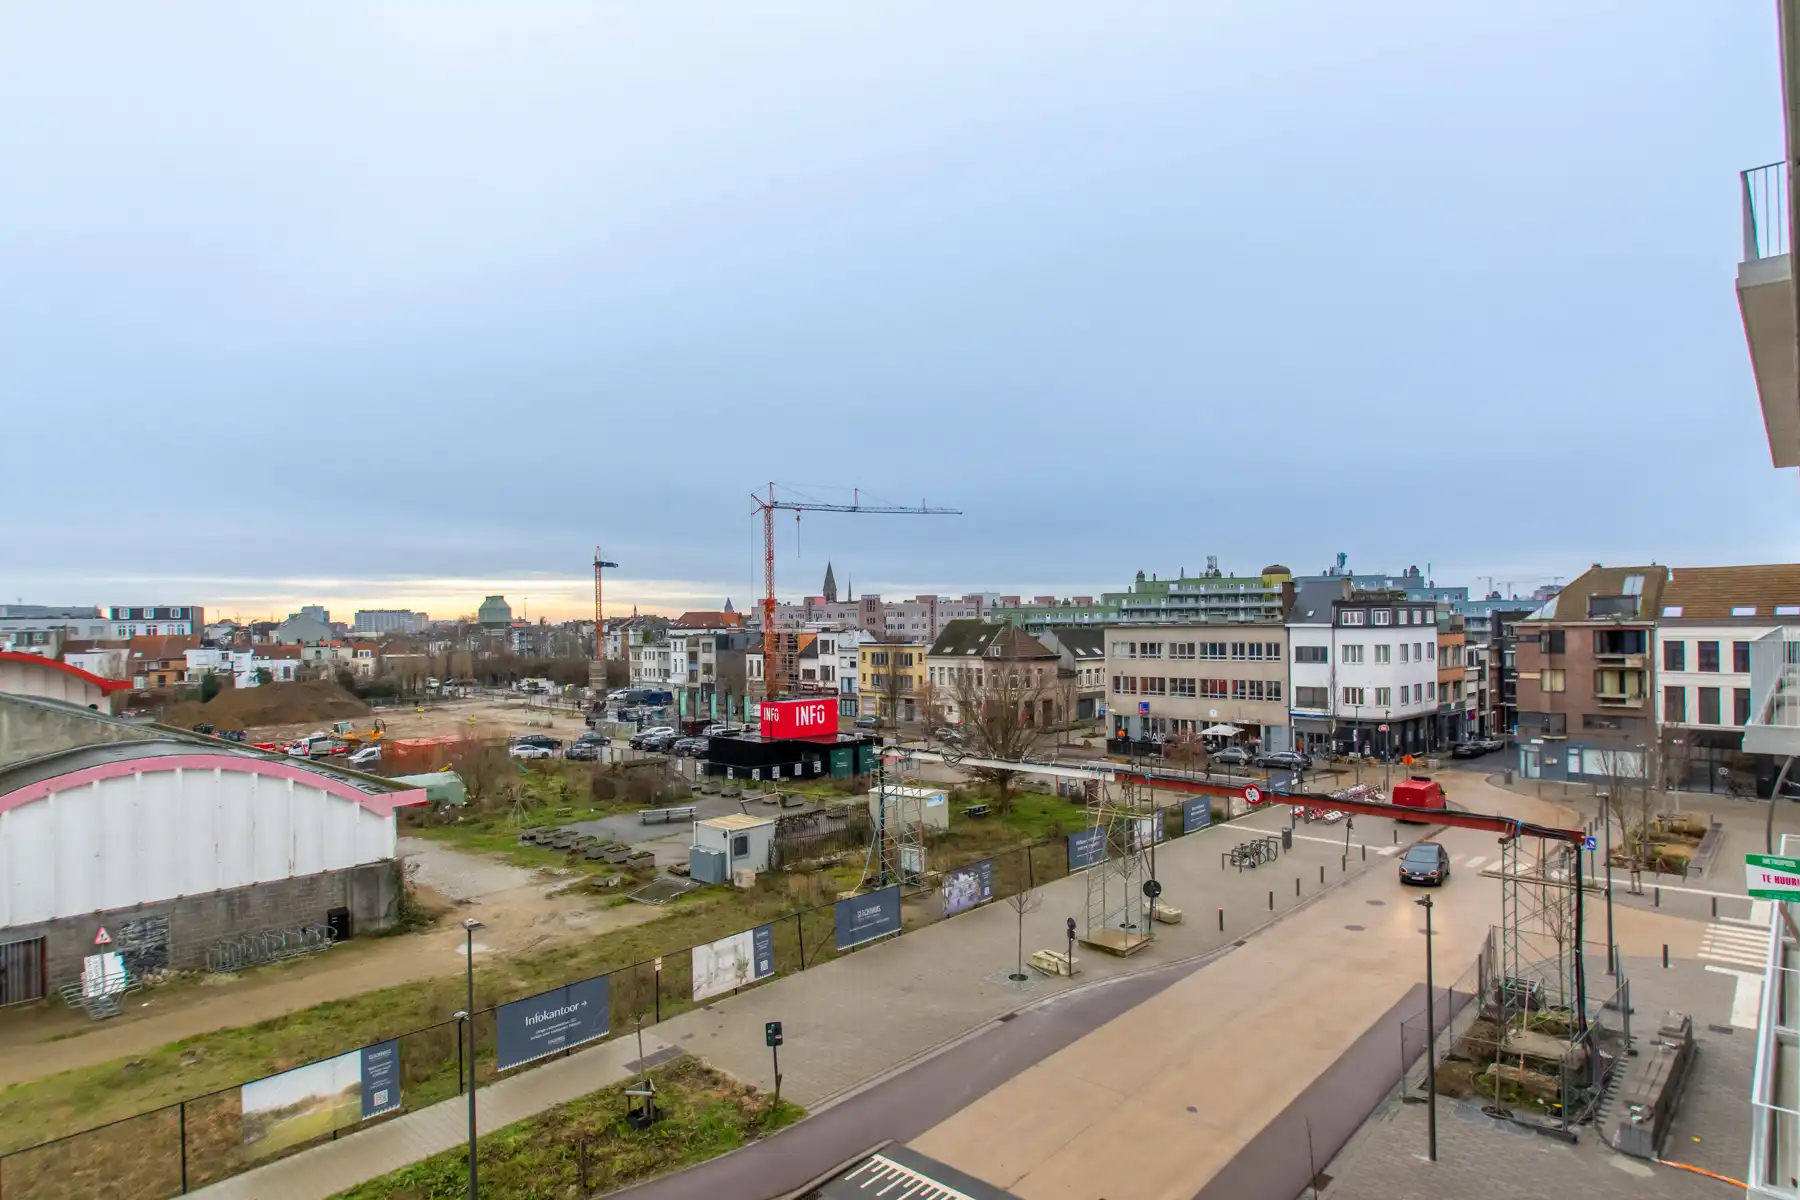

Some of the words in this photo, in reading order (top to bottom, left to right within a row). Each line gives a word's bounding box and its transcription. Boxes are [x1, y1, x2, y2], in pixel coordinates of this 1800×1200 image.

[763, 707, 779, 722] INFO
[796, 704, 825, 726] INFO
[1761, 874, 1771, 883] TE
[525, 1001, 580, 1026] Infokantoor
